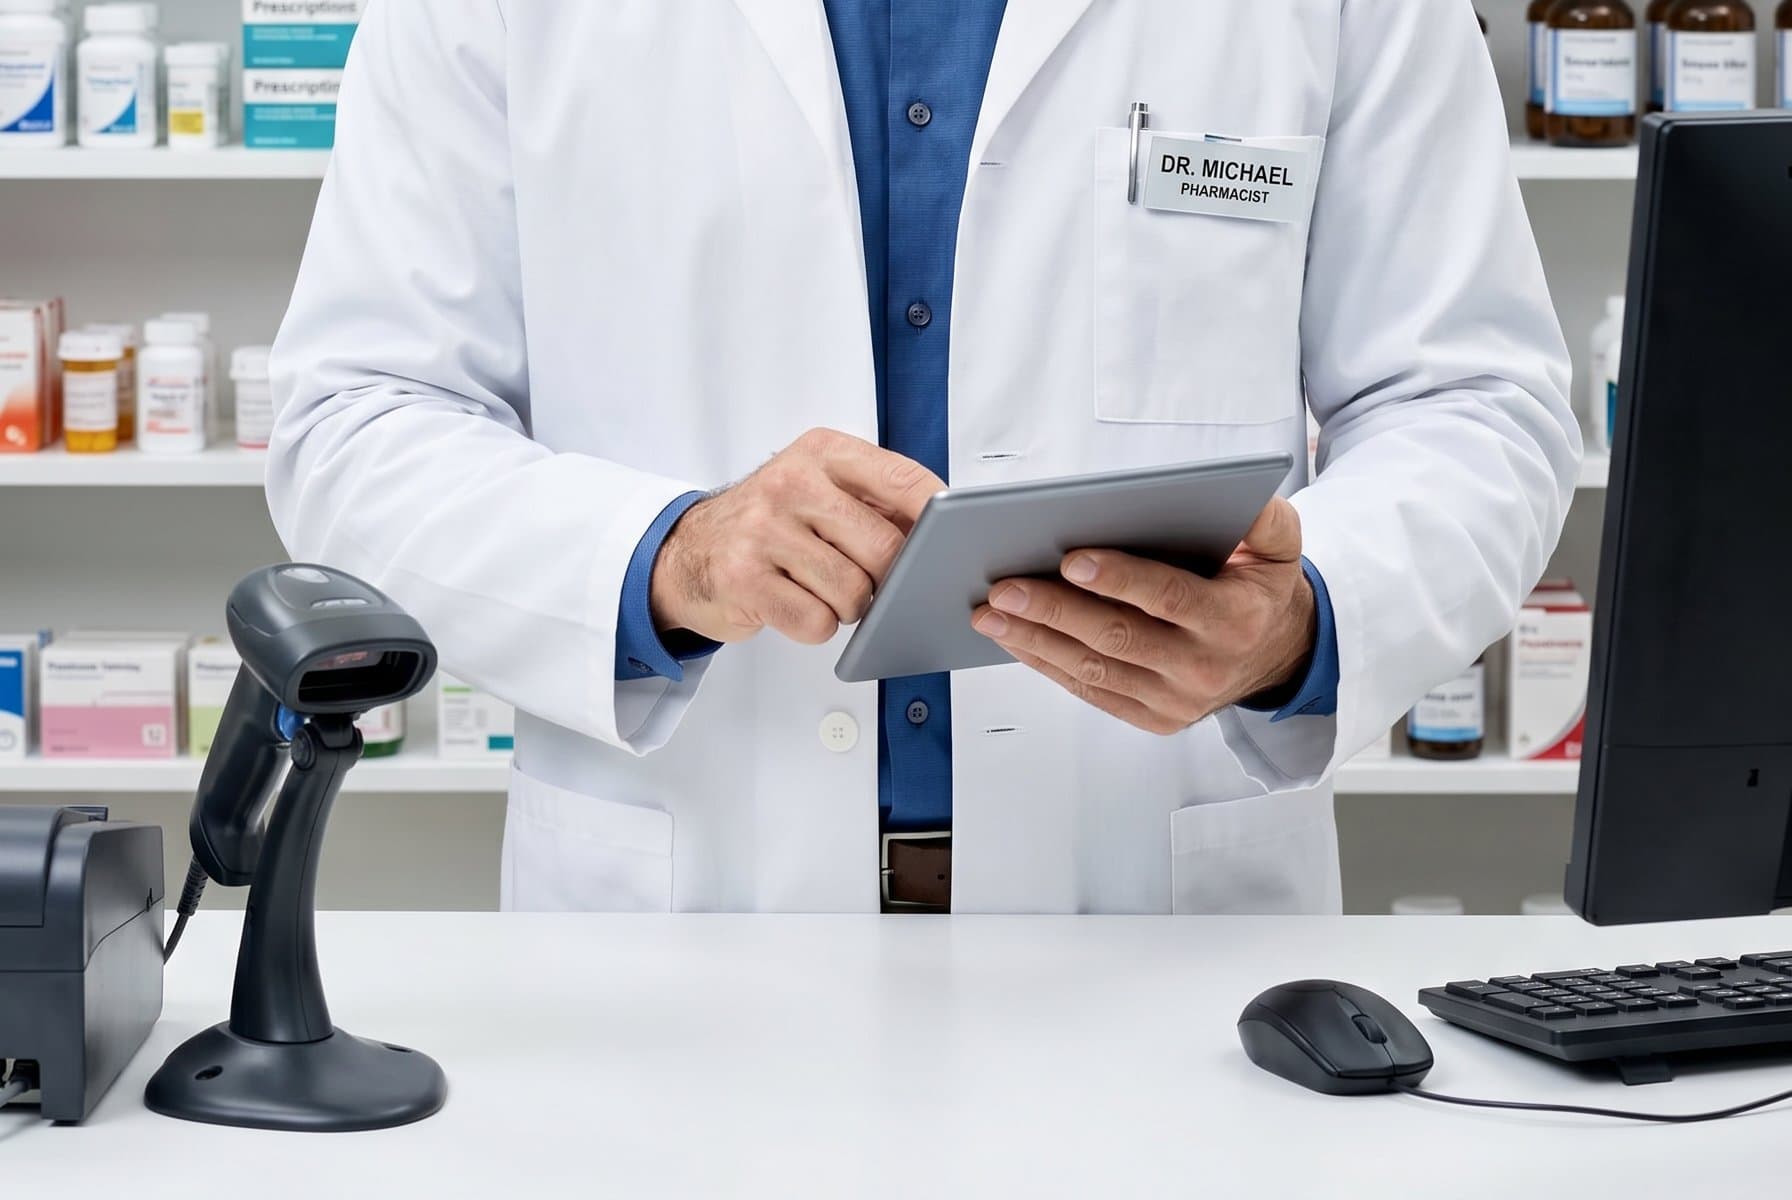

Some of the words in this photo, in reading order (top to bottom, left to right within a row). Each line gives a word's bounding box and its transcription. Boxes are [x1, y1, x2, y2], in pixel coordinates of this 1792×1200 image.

[1160, 154, 1195, 176] DR.
[1202, 159, 1294, 186] MICHAEL
[1180, 182, 1270, 204] PHARMACIST
